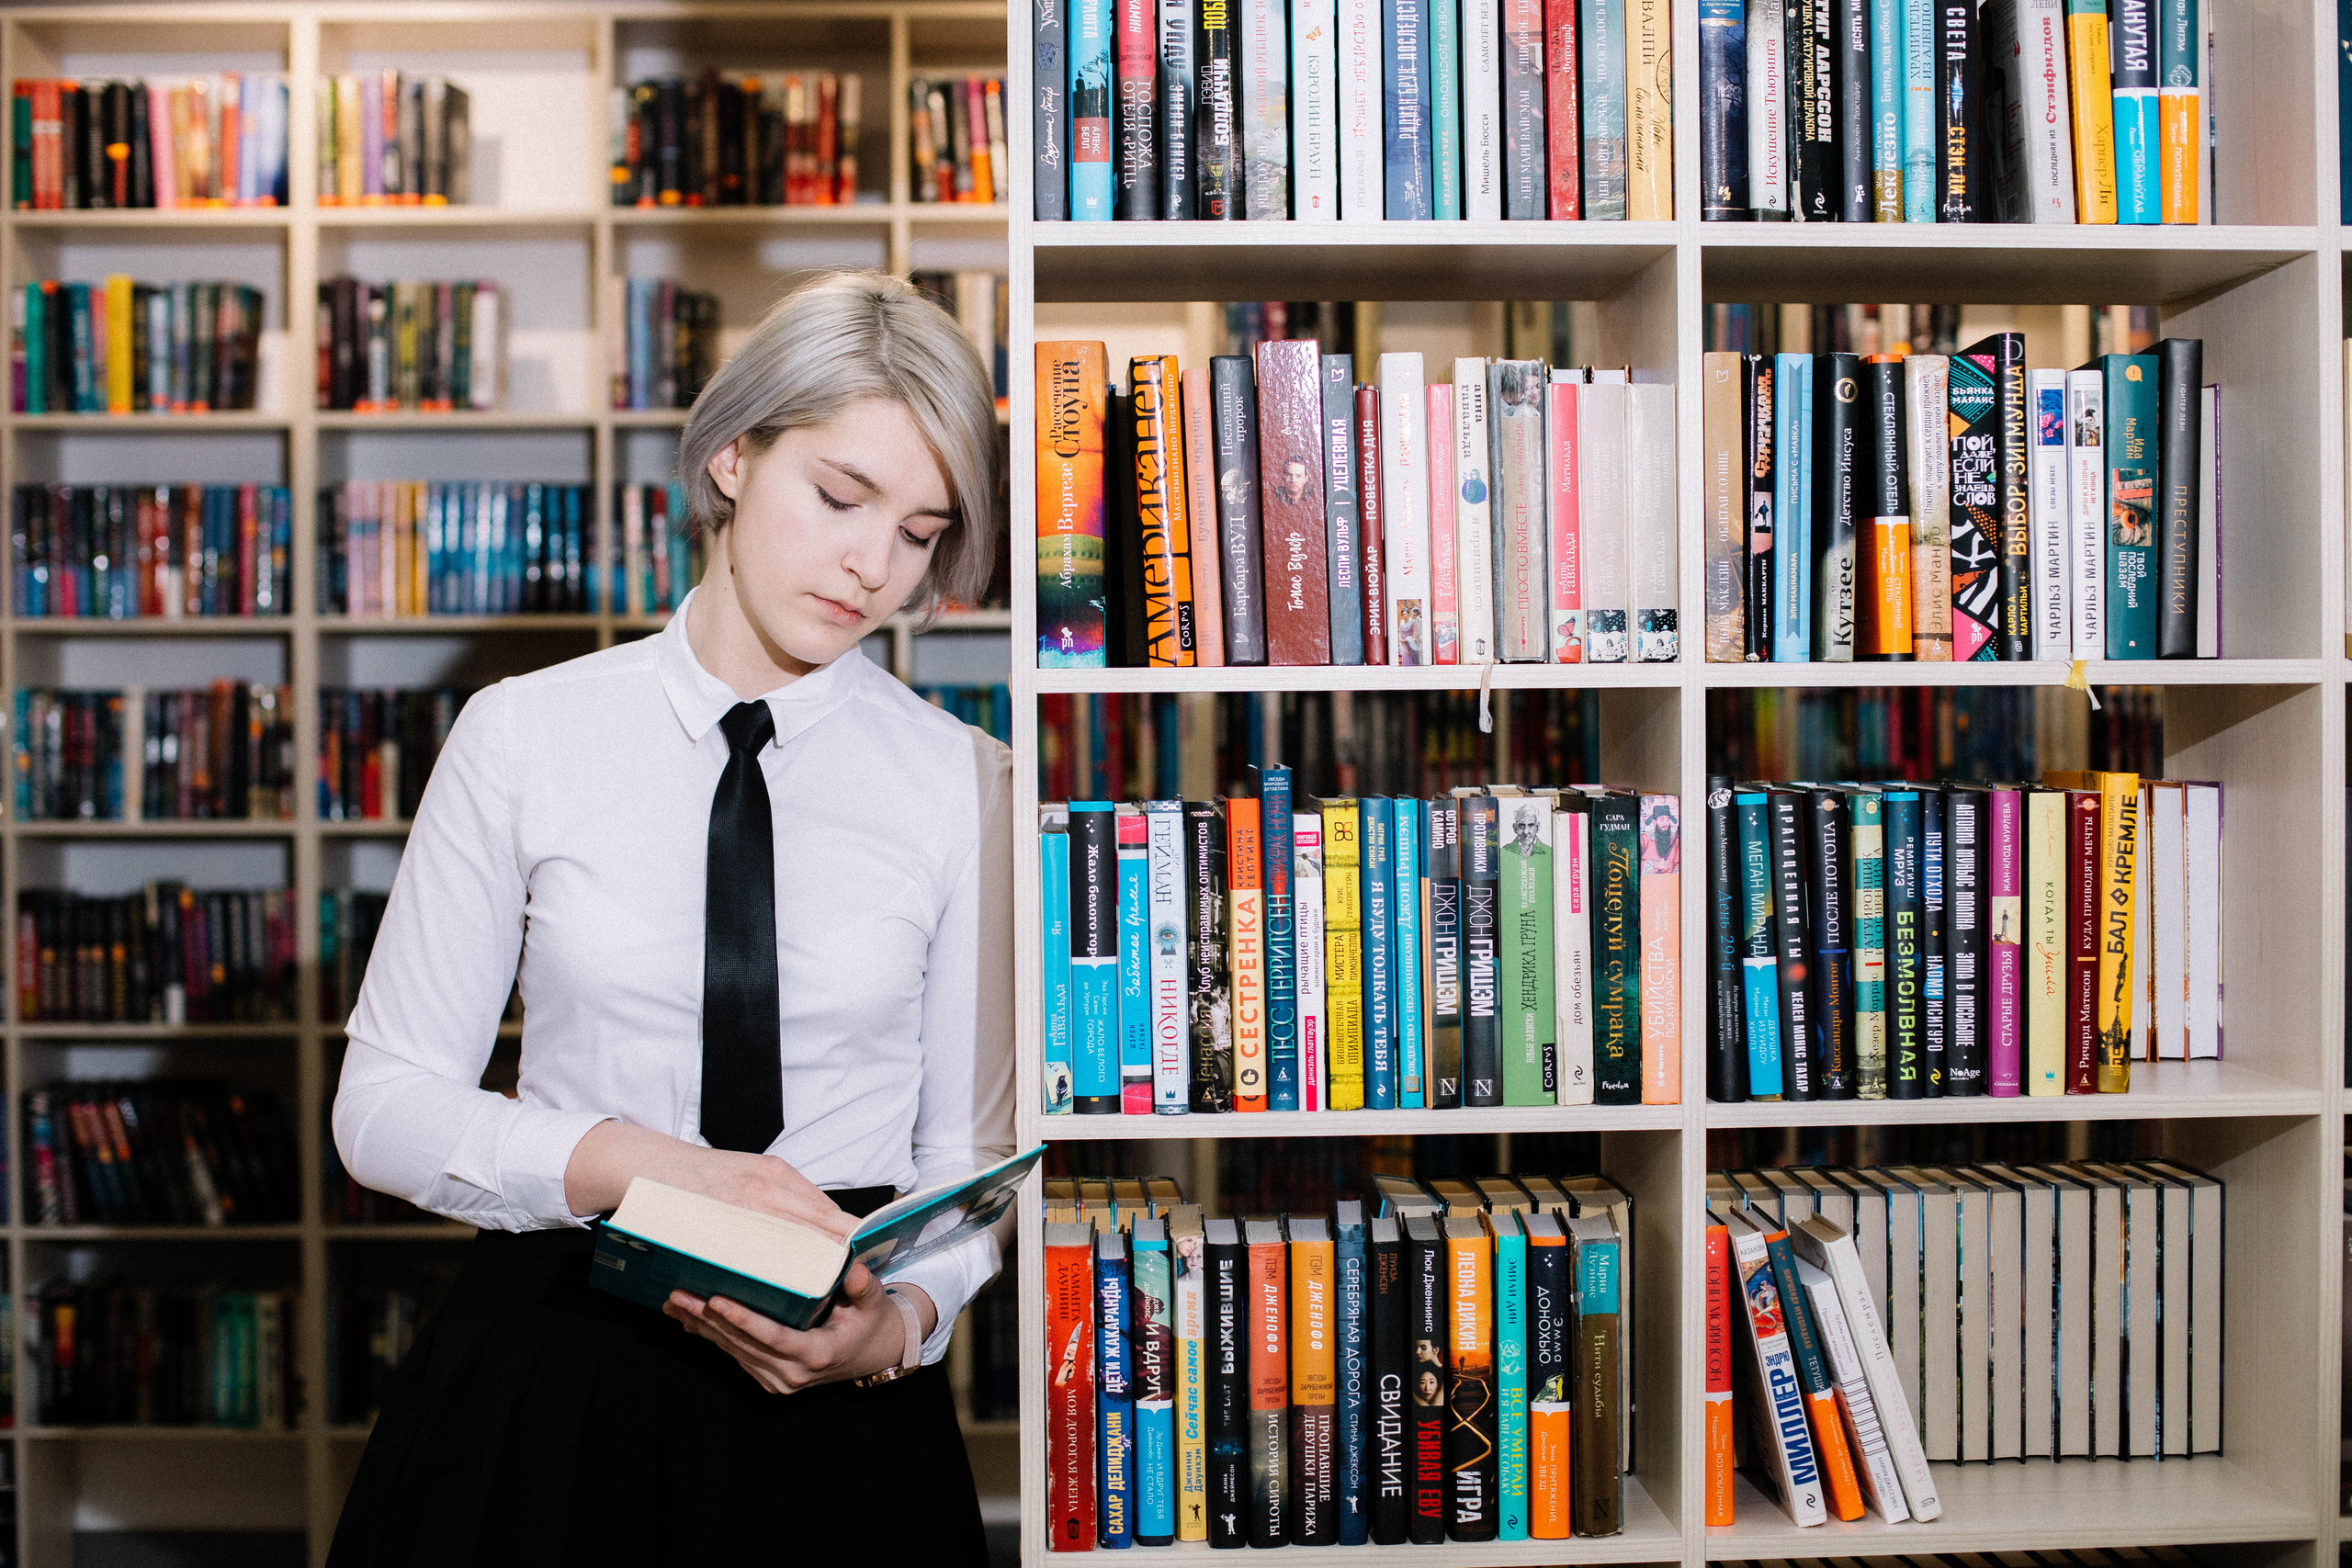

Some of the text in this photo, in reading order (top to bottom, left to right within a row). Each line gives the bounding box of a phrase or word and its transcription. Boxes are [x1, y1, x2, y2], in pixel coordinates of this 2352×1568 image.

[1851, 16, 1864, 51] ДЕСЯТЬ
[1880, 13, 1891, 43] небом
[1881, 46, 1892, 65] под
[1910, 1, 1920, 79] ХРАНИТЕЛЬ
[1947, 8, 1966, 61] СВЕТА
[1124, 81, 1136, 131] ОТЕЛЯ
[1214, 59, 1233, 146] БОЛДАЧЧИ
[1308, 55, 1321, 179] КЭРОЛИН БРАУН
[1438, 43, 1450, 118] ДОСТАТОЧНО
[1764, 39, 1778, 186] Искушение Тьюринга
[1805, 102, 1815, 141] ДРАКОНА
[1816, 44, 1831, 142] ЛАРССОН
[2042, 17, 2059, 186] ПОСЛЕДНЯЯ ИЗ Стэнфилдов
[1138, 82, 1152, 169] ГОСПОЖА
[1169, 133, 1184, 180] БЛИКЕР
[1480, 114, 1490, 195] Мишель Бюсси
[1880, 112, 1898, 215] Леклезио
[2100, 182, 2111, 204] Ли
[2174, 147, 2182, 208] ПОМУТНЕНИЕ
[1332, 419, 1349, 491] УЦЕЛЕВШАЯ
[1363, 420, 1376, 520] ПОВЕСТКА ДНЯ
[1562, 441, 1572, 492] Матильда
[1791, 468, 1799, 504] ПИСЬМА
[1953, 459, 1995, 472] ЕСЛИ
[2004, 365, 2026, 556] ВЫБОР ЗИГМУНДА
[1058, 463, 1081, 589] Абрахам Вергезе
[1840, 476, 1852, 525] Детство
[1231, 515, 1250, 616] Барбара ВУД
[1337, 516, 1351, 588] ЛЕСЛИ ВУЛЬФ
[1365, 546, 1380, 635] ЭРИК ВЮЙАР
[1516, 502, 1529, 610] ПРОСТО ВМЕСТЕ
[1790, 553, 1798, 619] ЭЛИ МАКНАМАРА
[2047, 521, 2061, 639] ЧАРЛЬЗ МАРТИН
[2172, 486, 2188, 614] ПРЕСТУПНИКИ
[1832, 557, 1854, 648] Кутзее
[2007, 605, 2018, 636] КАРЛО
[1087, 844, 1100, 919] Жало белого
[1197, 821, 1210, 993] Клуб неисправимых оптимистов
[1571, 857, 1579, 883] груэн
[1749, 841, 1762, 887] МЕГАН
[1824, 821, 1838, 943] ПОСЛЕ ПОТОПА
[1894, 849, 1904, 886] МРУЗ
[1906, 837, 1915, 898] РЕМИГИУШ
[1927, 832, 1942, 911] ПУТИ ОТХОДА
[2084, 817, 2094, 949] КУДА ПРИВОДЯТ МЕЧТЫ
[2108, 795, 2138, 953] БАЛ КРЕМЛЕ
[1237, 897, 1259, 1058] СЕСТРЕНКА
[1298, 902, 1310, 995] рычащие птицы
[1334, 935, 1344, 980] МИСТЕРА
[1371, 881, 1387, 1071] Я БУДУ ТОЛКАТЬ ТЕБЯ
[1572, 951, 1583, 1025] дом обезьян
[1647, 937, 1665, 1038] УБИЙСТВА
[1347, 999, 1359, 1064] ОЛИМПИАДА
[1897, 911, 1917, 1079] БЕЗМОЛВНАЯ
[1928, 956, 1943, 1051] НАОМИ ИСИГУРО
[2001, 951, 2013, 1046] СТАРЫЕ ДРУЗЬЯ
[2079, 970, 2092, 1068] Ричард Матесон
[1307, 1055, 1316, 1086] даниэль
[1792, 991, 1808, 1091] ХЕЛЕН МОНКС ТАХАР
[1220, 1260, 1234, 1374] ВЫЖИВШИЕ
[1423, 1249, 1436, 1332] Люк Дженнингс
[1457, 1252, 1477, 1350] ЛЕОНА ДИКИН
[1598, 1255, 1609, 1293] Мария
[1103, 1278, 1124, 1393] ДЕТИ ЖАКАРАНДЫ
[1348, 1258, 1361, 1408] СЕРЕБРЯНАЯ ДОРОГА
[1538, 1287, 1550, 1363] ДОНОХЬЮ
[1766, 1355, 1790, 1367] ЭНДРЮ
[1185, 1340, 1198, 1439] Сейчас самое
[1770, 1368, 1816, 1485] МИЛЛЕР
[1068, 1389, 1078, 1512] МОЯ ДОРОГАЯ ЖЕНА
[1107, 1412, 1125, 1534] САХАР ДЕЛИДЖАНИ
[1184, 1450, 1194, 1492] Дженни
[1193, 1449, 1204, 1492] Даунхэм
[1269, 1414, 1280, 1536] ИСТОРИЯ СИРОТЫ
[1318, 1415, 1330, 1501] ПРОПАВШИЕ
[1350, 1445, 1359, 1489] ДЖЕКСОН
[1380, 1374, 1403, 1496] СВИДАНИЕ
[1418, 1420, 1442, 1517] УБИВАЯ ЕВУ
[1715, 1453, 1724, 1517] ВОЗЛЮБЛЕННАЯ
